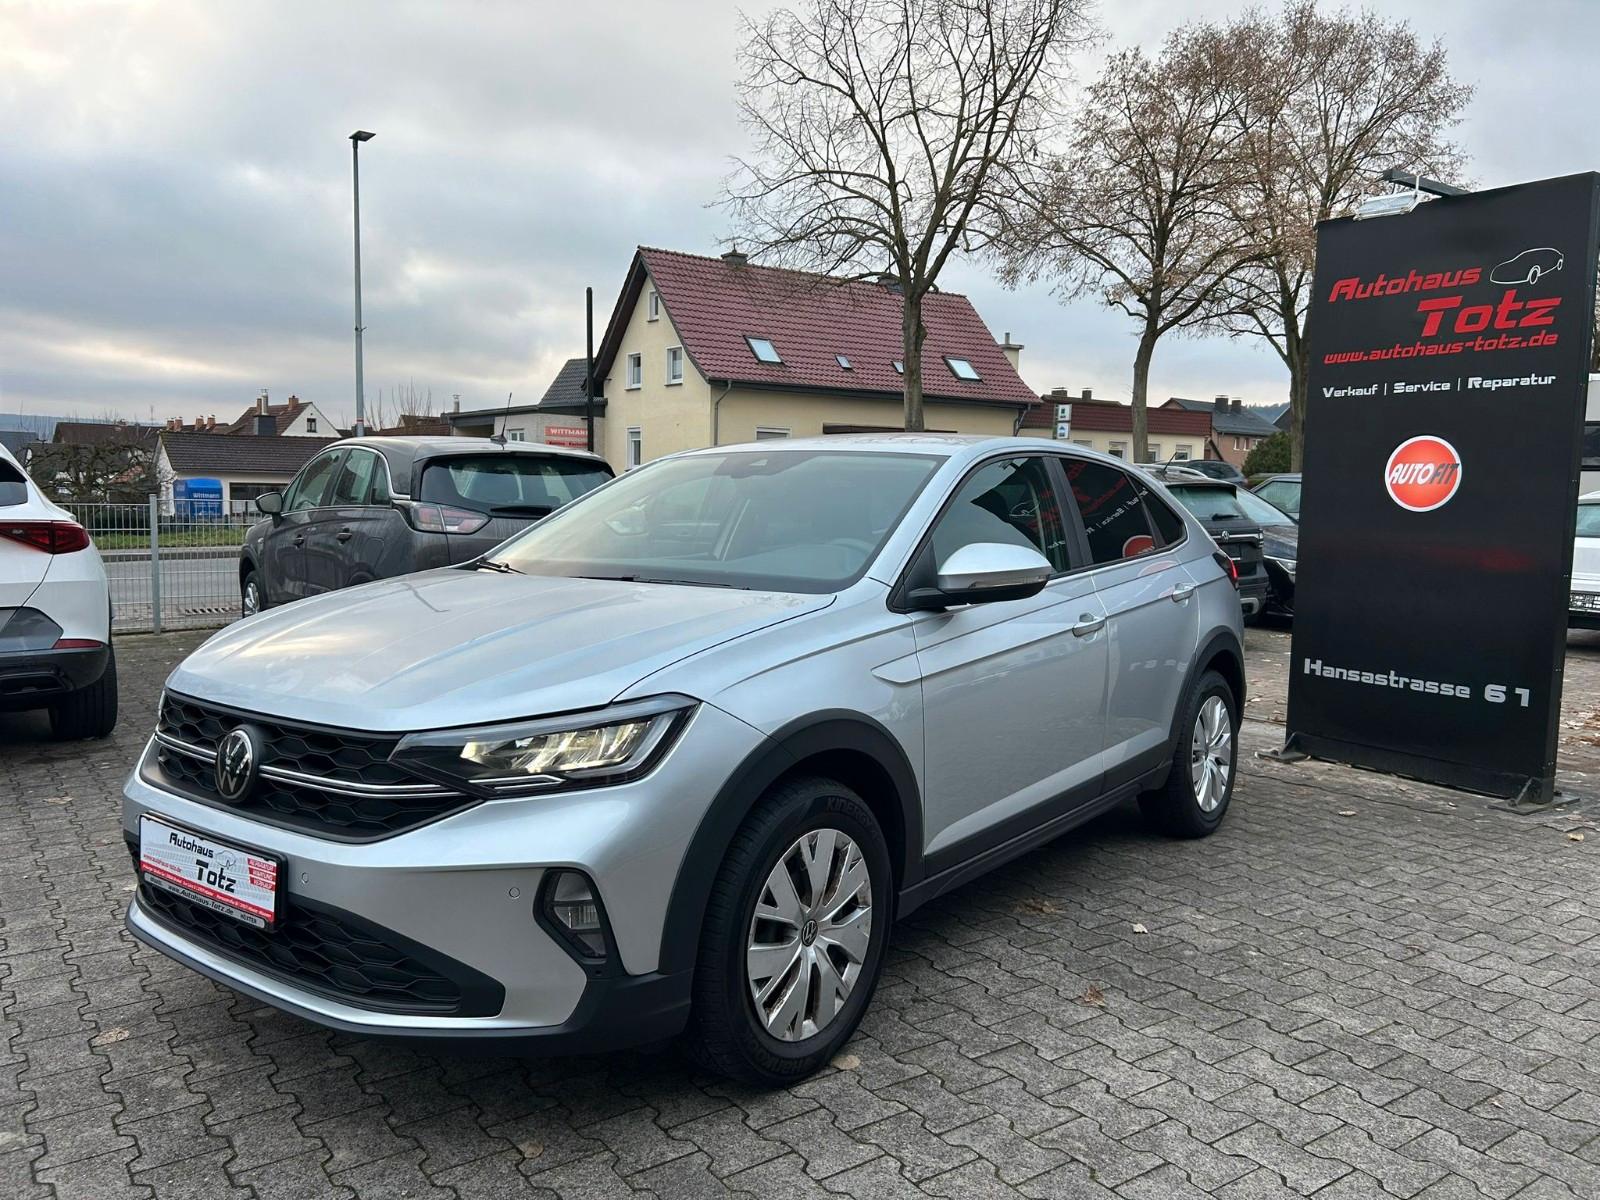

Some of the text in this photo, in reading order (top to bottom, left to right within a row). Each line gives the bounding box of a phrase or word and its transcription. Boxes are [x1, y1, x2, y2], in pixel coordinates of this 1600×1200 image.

[1328, 267, 1482, 303] Autohaus
[1417, 289, 1562, 337] Totz
[1323, 330, 1559, 365] www.autohaus-totz.de
[1323, 373, 1556, 398] Verkauf Service Reparatur
[1390, 463, 1460, 485] AUTOFIT
[1303, 657, 1471, 699] Hansastrasse
[169, 832, 214, 859] Autohaus
[195, 859, 237, 893] Totz
